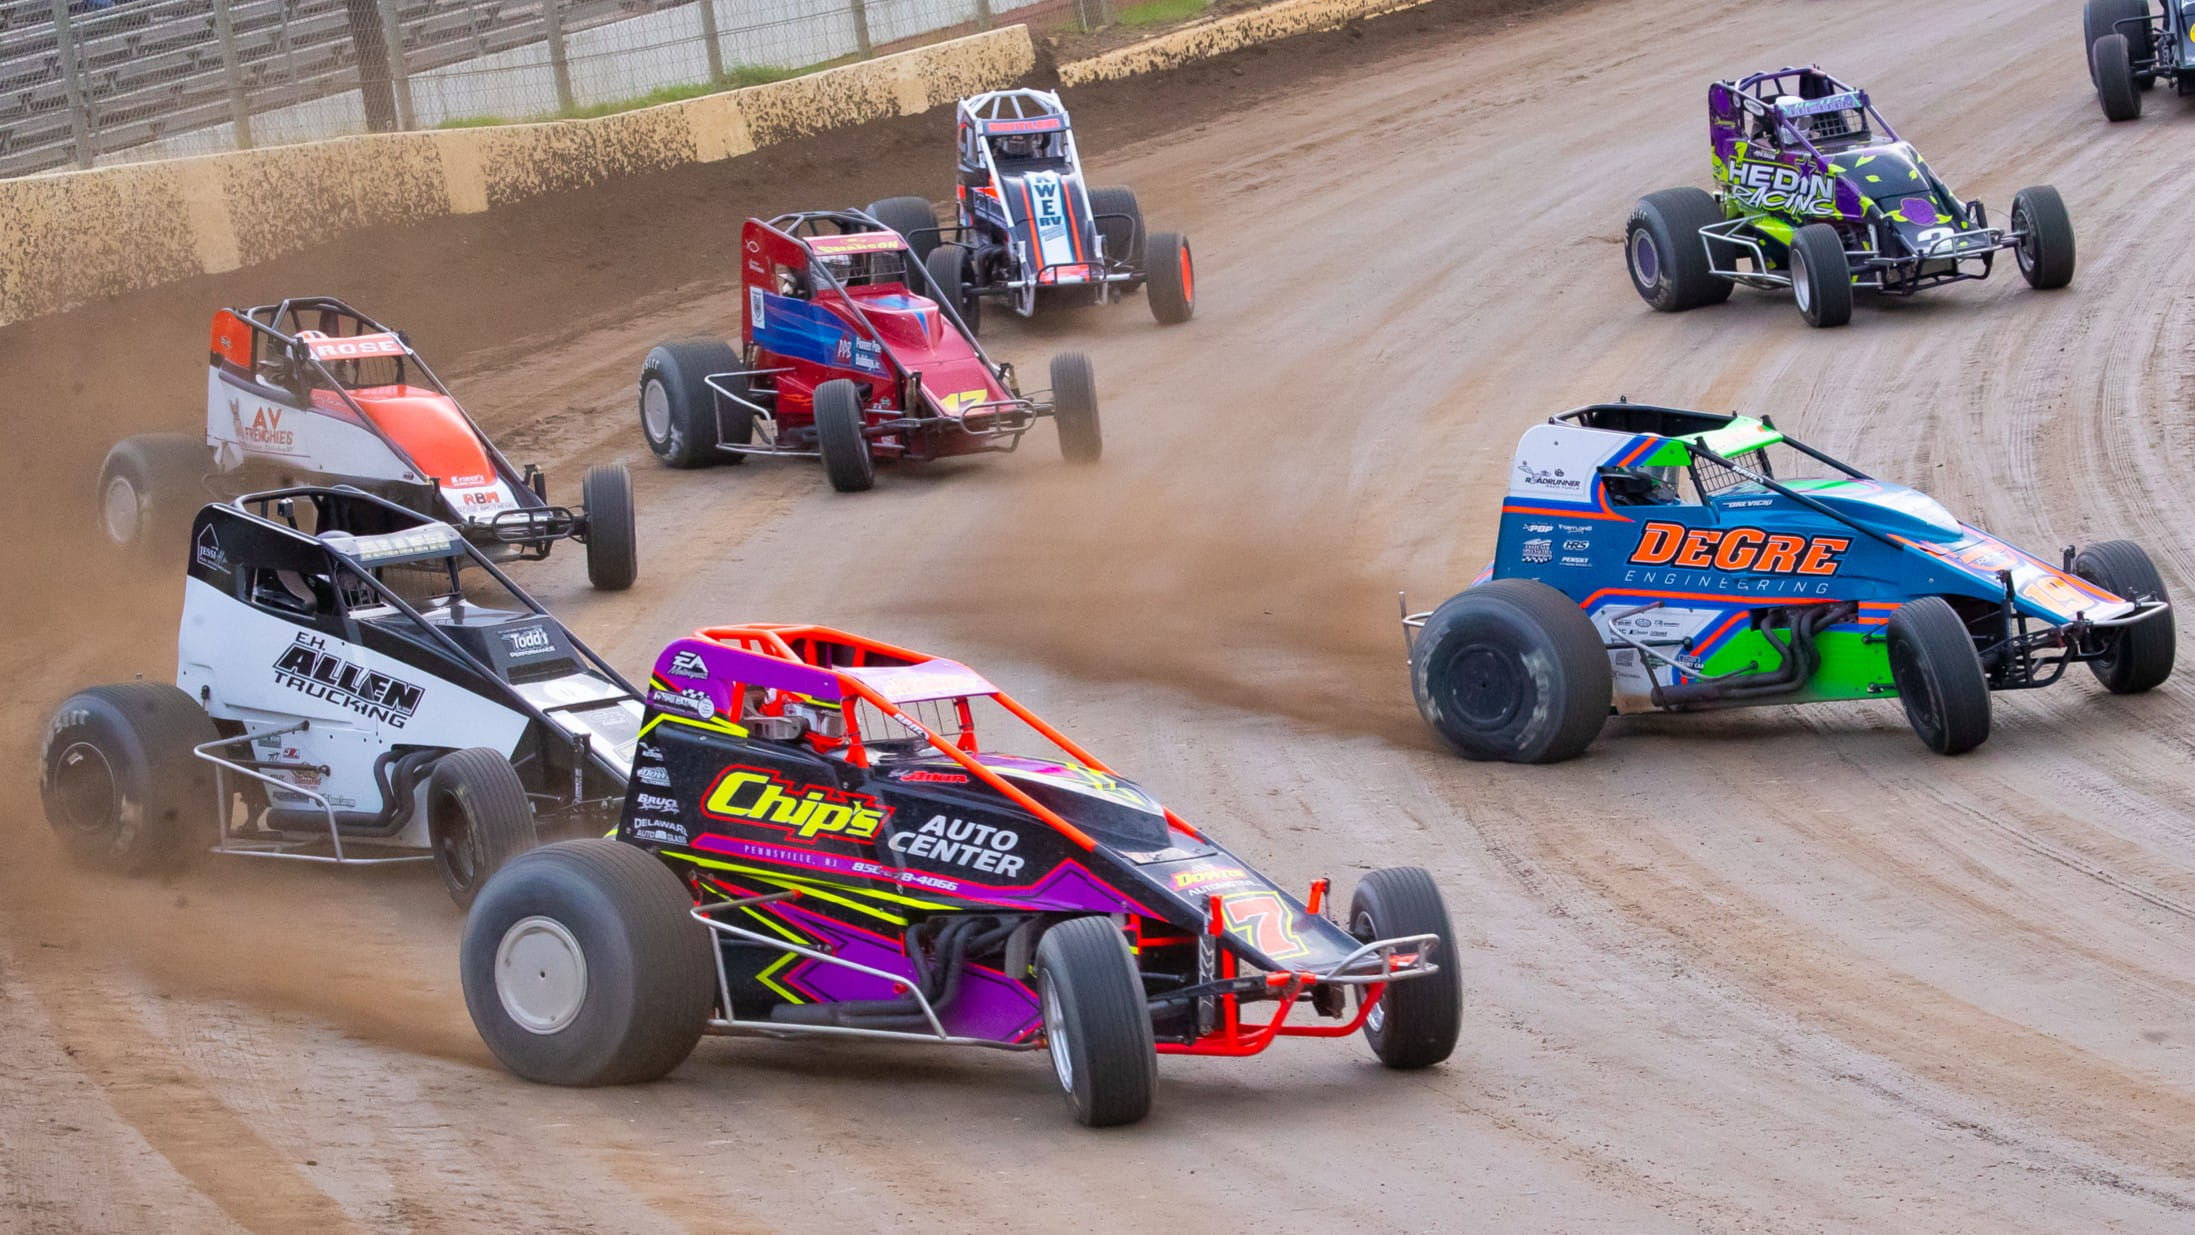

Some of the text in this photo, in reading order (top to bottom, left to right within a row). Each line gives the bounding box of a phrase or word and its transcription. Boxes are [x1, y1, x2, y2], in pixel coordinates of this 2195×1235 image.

[1731, 185, 1834, 215] RACING
[317, 341, 398, 356] ROSE
[253, 407, 282, 430] AV
[463, 492, 500, 505] RBM
[1565, 540, 1588, 550] HRS
[1625, 570, 1829, 594] ENGINEERING
[295, 631, 326, 651] E.H.
[510, 627, 549, 649] Todd's
[673, 651, 708, 672] EA
[274, 643, 424, 715] ALLEN
[275, 670, 408, 729] TRUCKING
[706, 770, 886, 838] Chip's
[920, 814, 1019, 850] AUTO
[888, 831, 1025, 878] CENTER
[1226, 896, 1299, 956] 7
